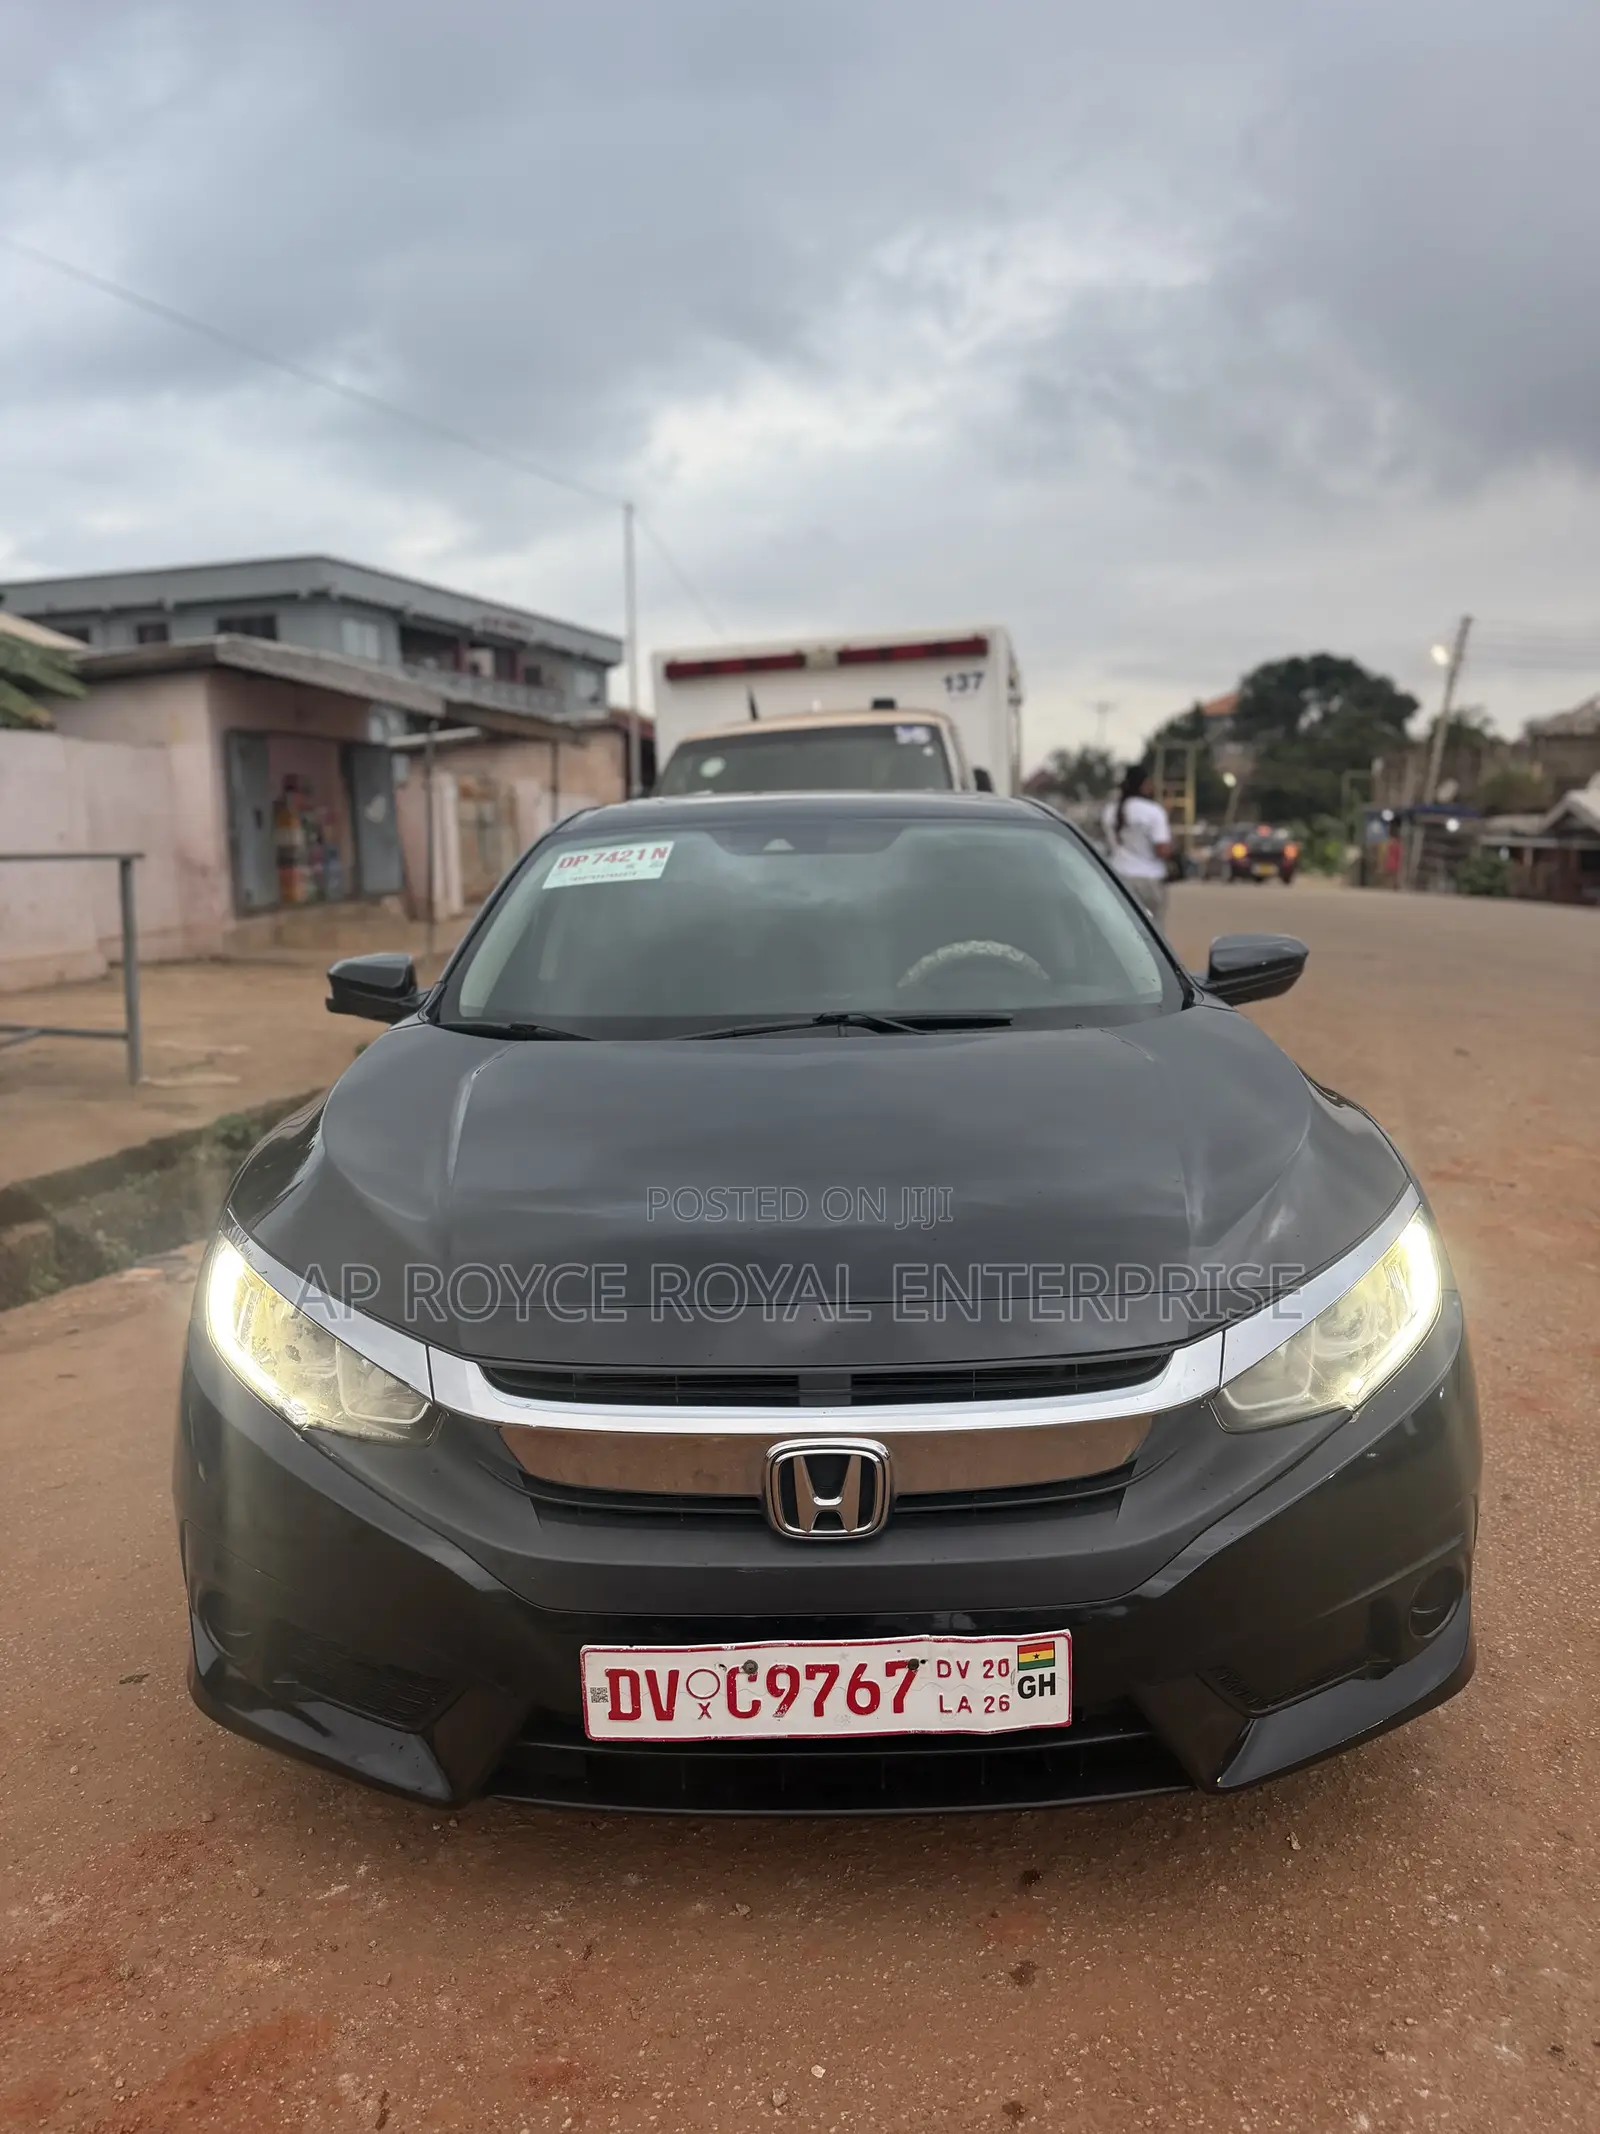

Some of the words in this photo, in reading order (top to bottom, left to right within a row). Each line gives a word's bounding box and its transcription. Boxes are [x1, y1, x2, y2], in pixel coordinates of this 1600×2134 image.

[943, 672, 984, 692] 137
[936, 1659, 970, 1679] DV
[983, 1658, 1010, 1679] 20
[605, 1668, 680, 1721] DV
[727, 1660, 917, 1719] C9767
[1017, 1672, 1056, 1699] GH
[939, 1694, 972, 1713] LA
[983, 1694, 1010, 1713] 26
